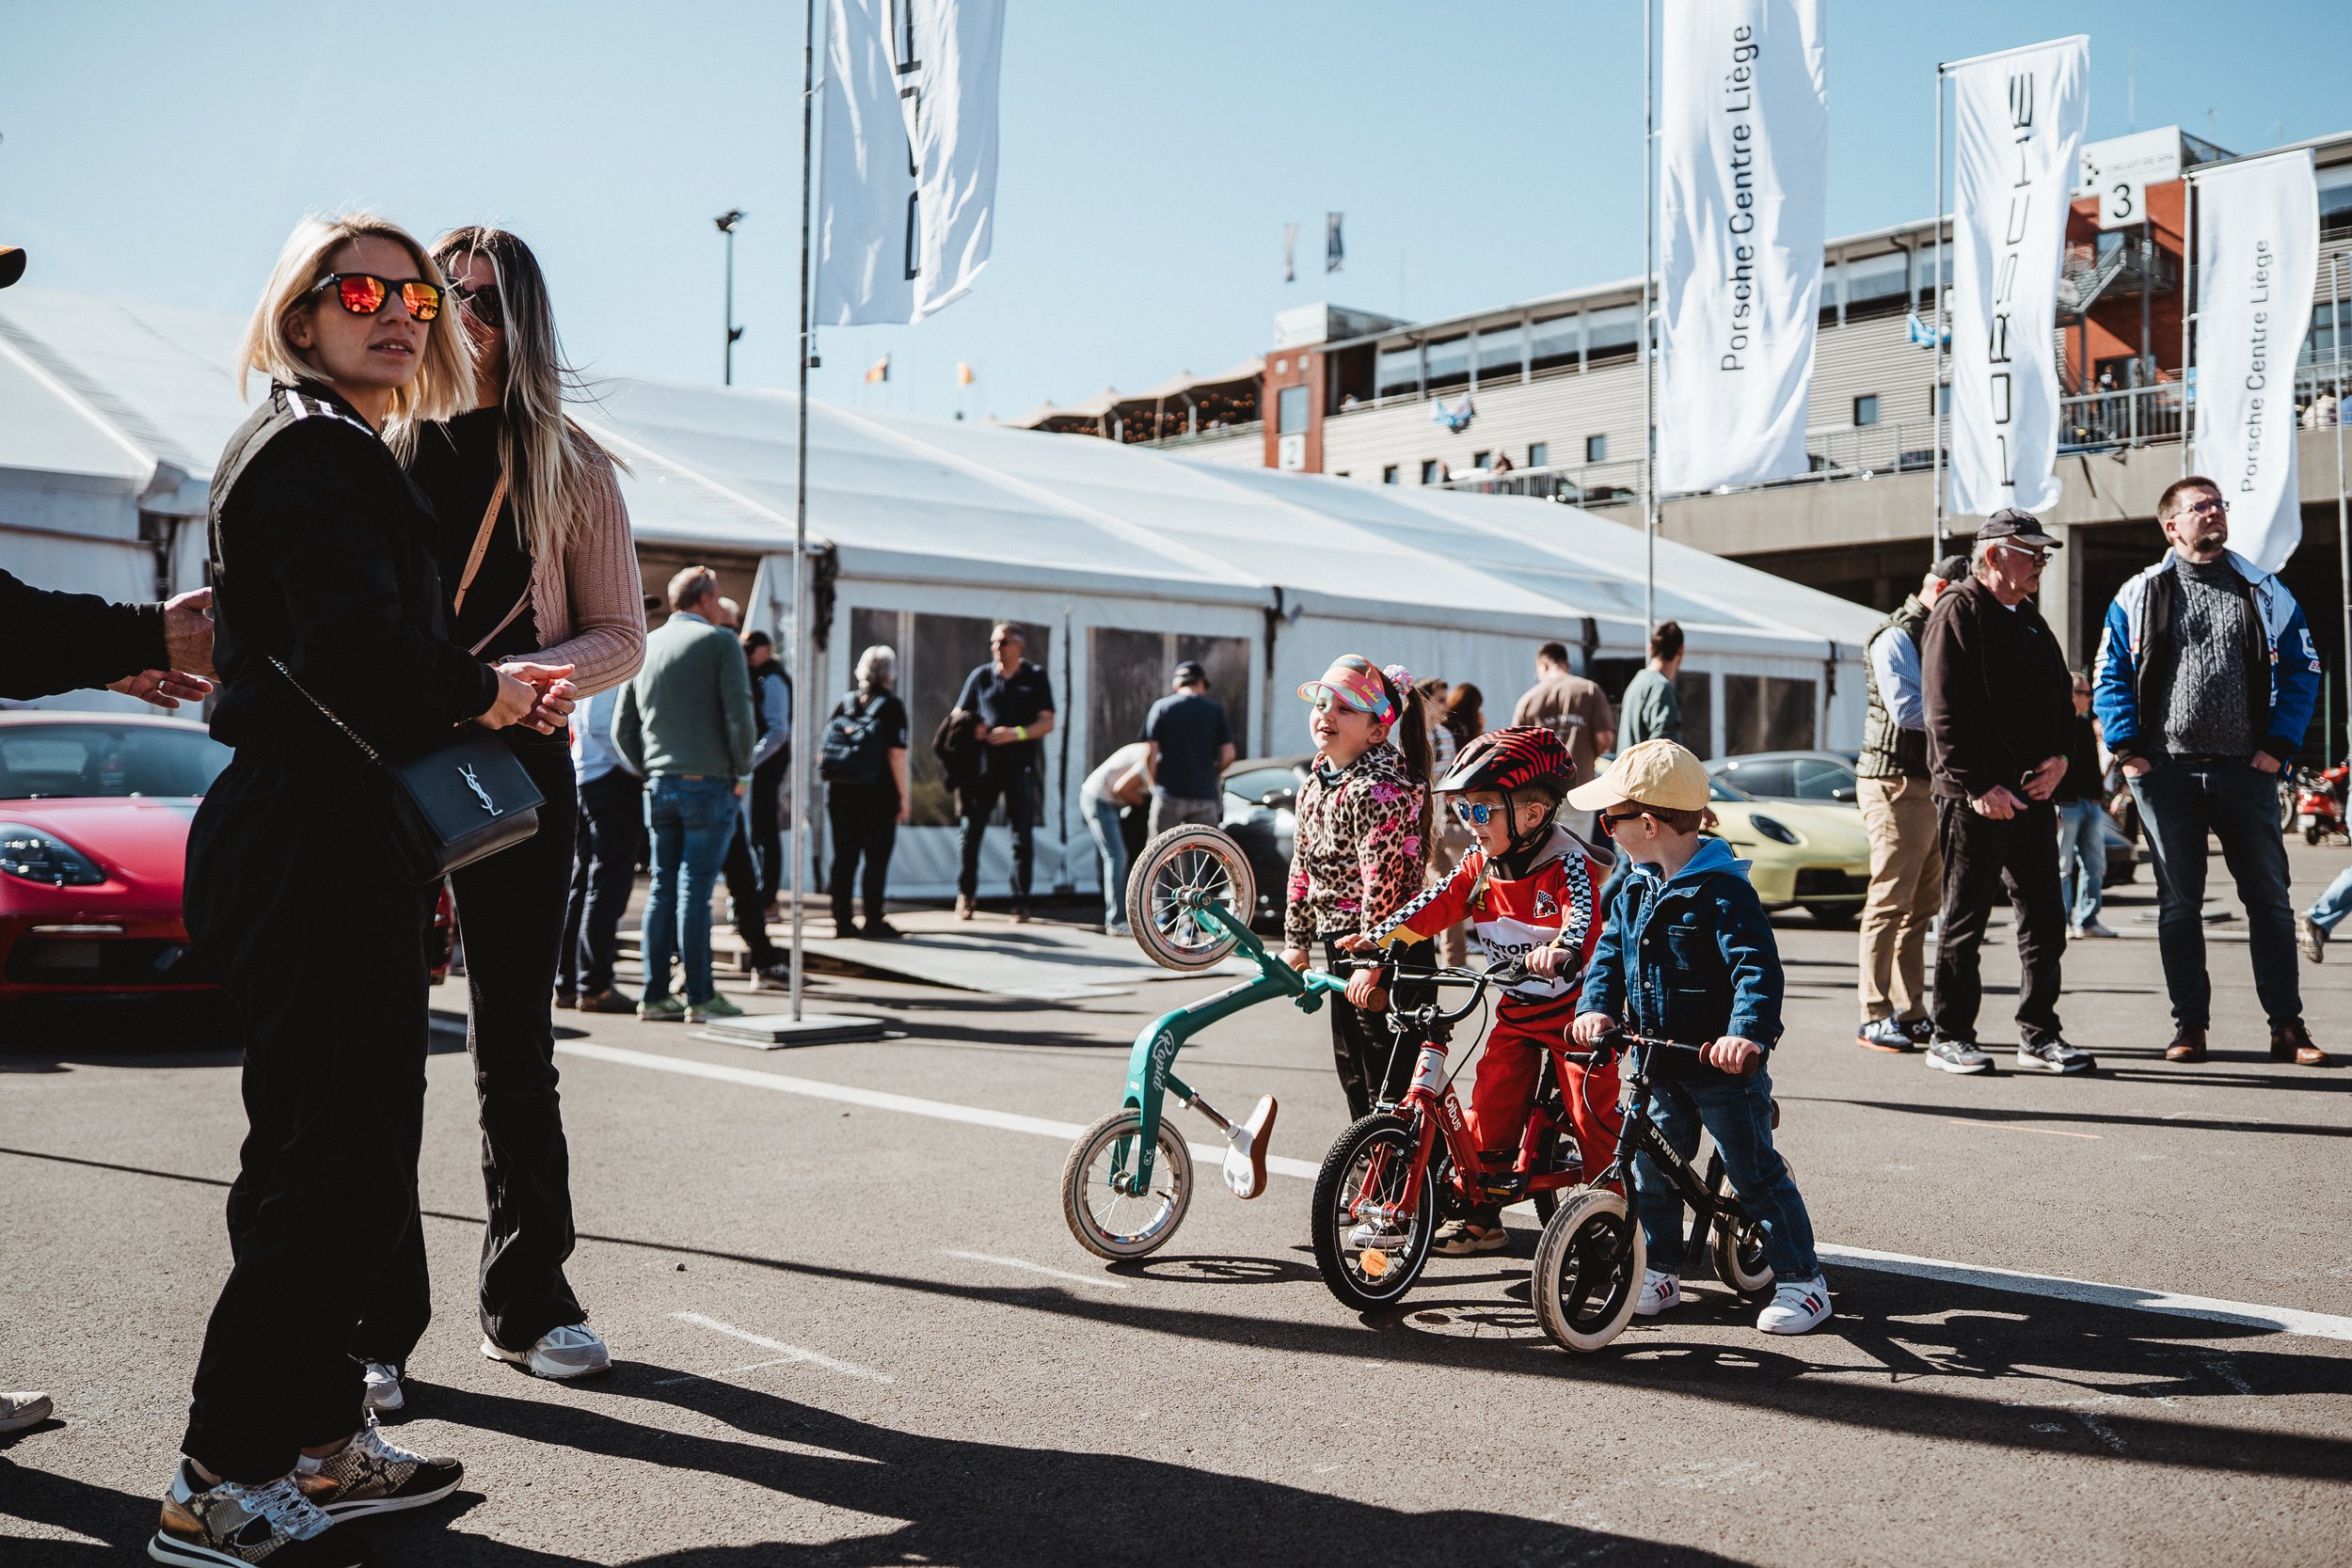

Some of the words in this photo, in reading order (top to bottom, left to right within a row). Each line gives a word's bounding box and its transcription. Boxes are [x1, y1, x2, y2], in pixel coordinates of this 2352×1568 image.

[1724, 24, 1759, 113] Liège
[1729, 124, 1755, 234] Centre
[2113, 183, 2132, 218] 3
[2250, 240, 2274, 304] Liège
[1721, 245, 1755, 372] Porsche
[2246, 311, 2267, 390] Centre
[1285, 440, 1297, 465] 2
[2241, 397, 2265, 492] Porsche
[456, 763, 504, 816] YSL
[1444, 1092, 1462, 1132] Gibus
